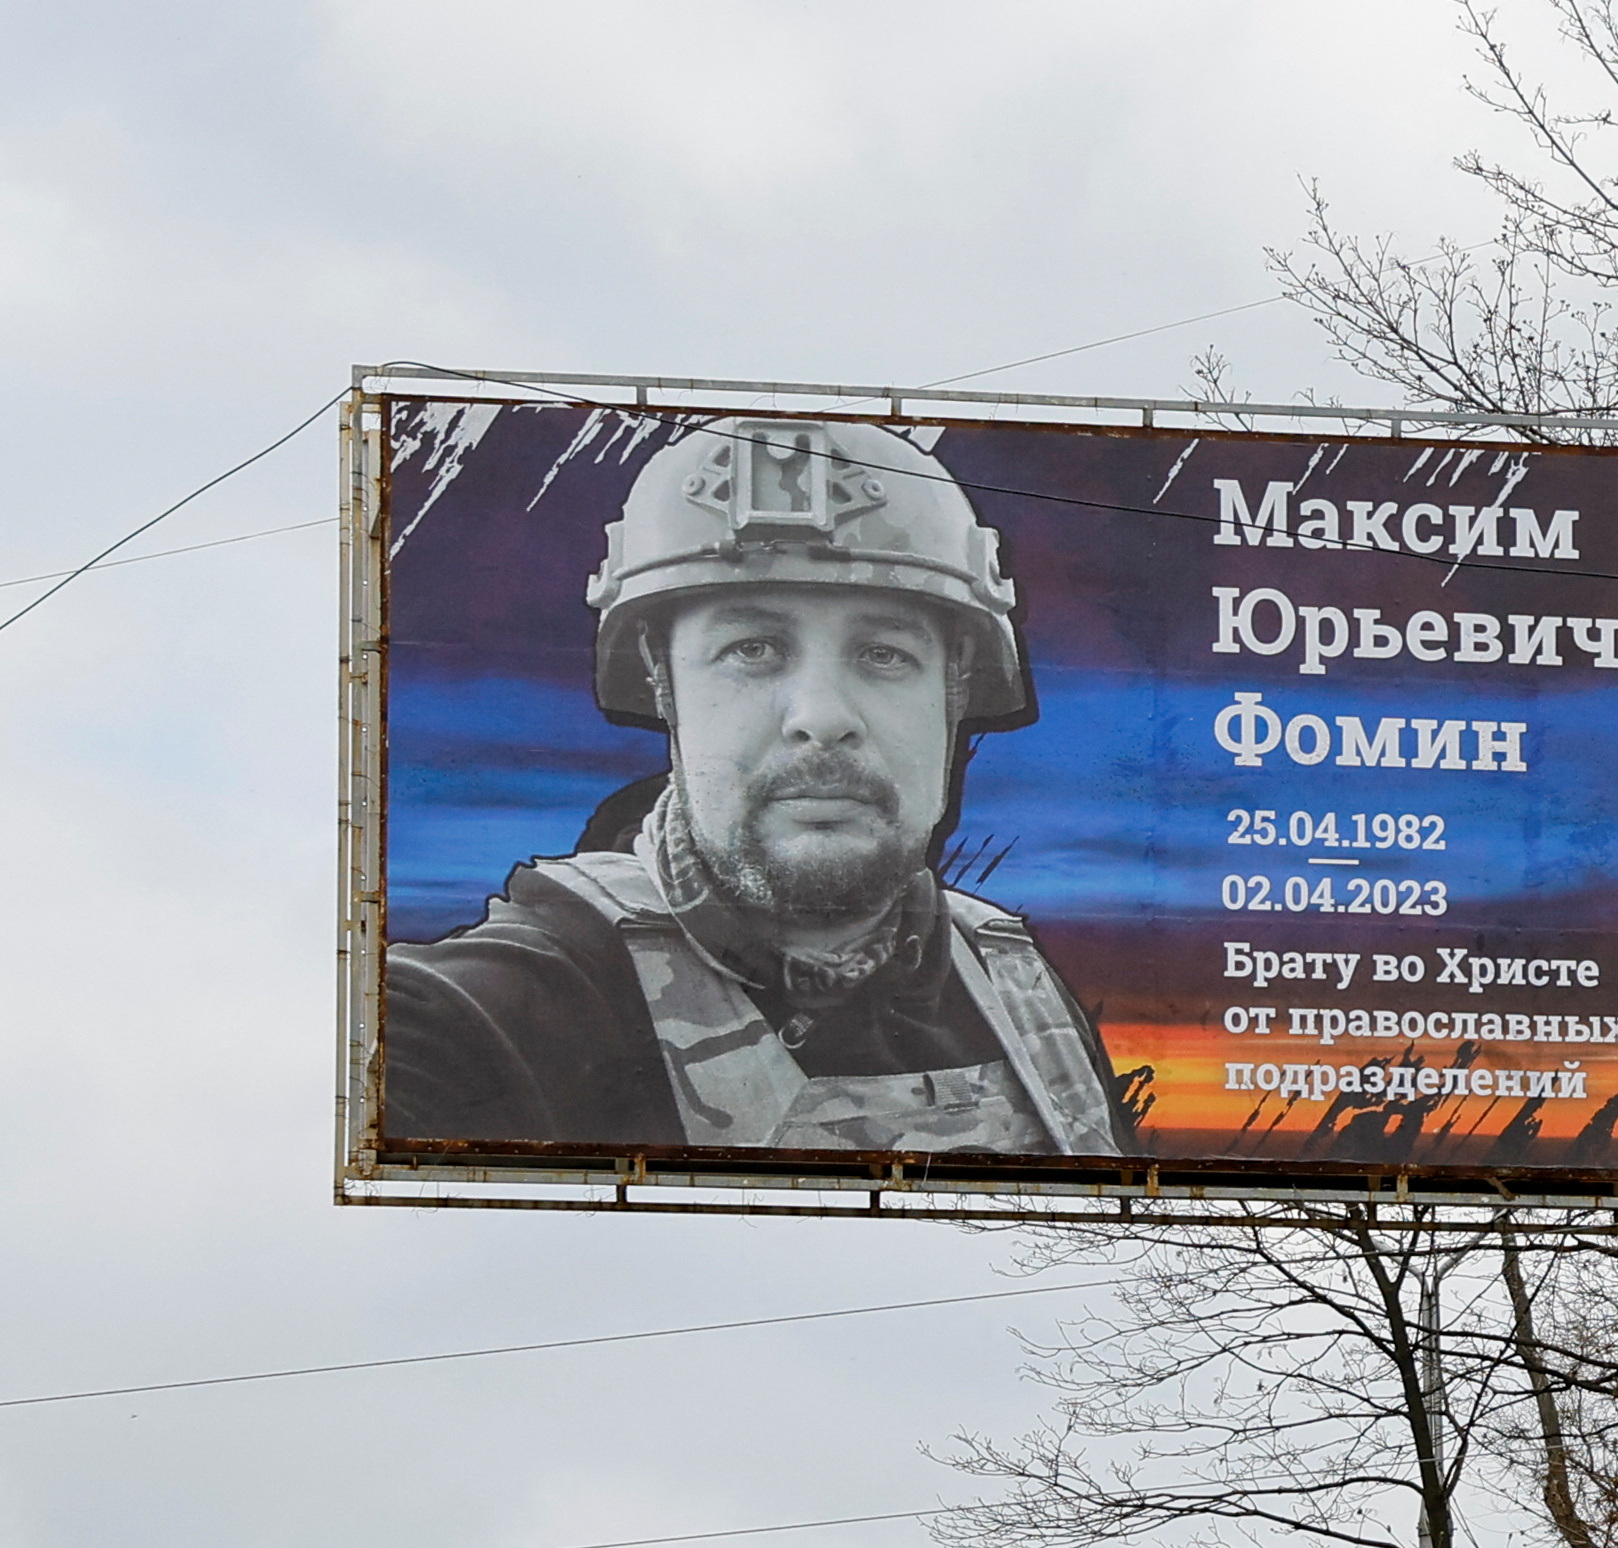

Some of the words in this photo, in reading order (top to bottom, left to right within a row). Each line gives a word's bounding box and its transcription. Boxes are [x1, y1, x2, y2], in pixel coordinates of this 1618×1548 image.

[1213, 479, 1580, 559] Максим
[1213, 692, 1527, 772] Фомин
[1227, 809, 1446, 850] 25.04.1982
[1222, 875, 1448, 916] 02.04.2023
[1224, 942, 1361, 990] Брату
[1373, 954, 1425, 982] во
[1436, 947, 1600, 993] Христе
[1224, 1007, 1276, 1034] от
[1225, 1062, 1587, 1101] подразделений
